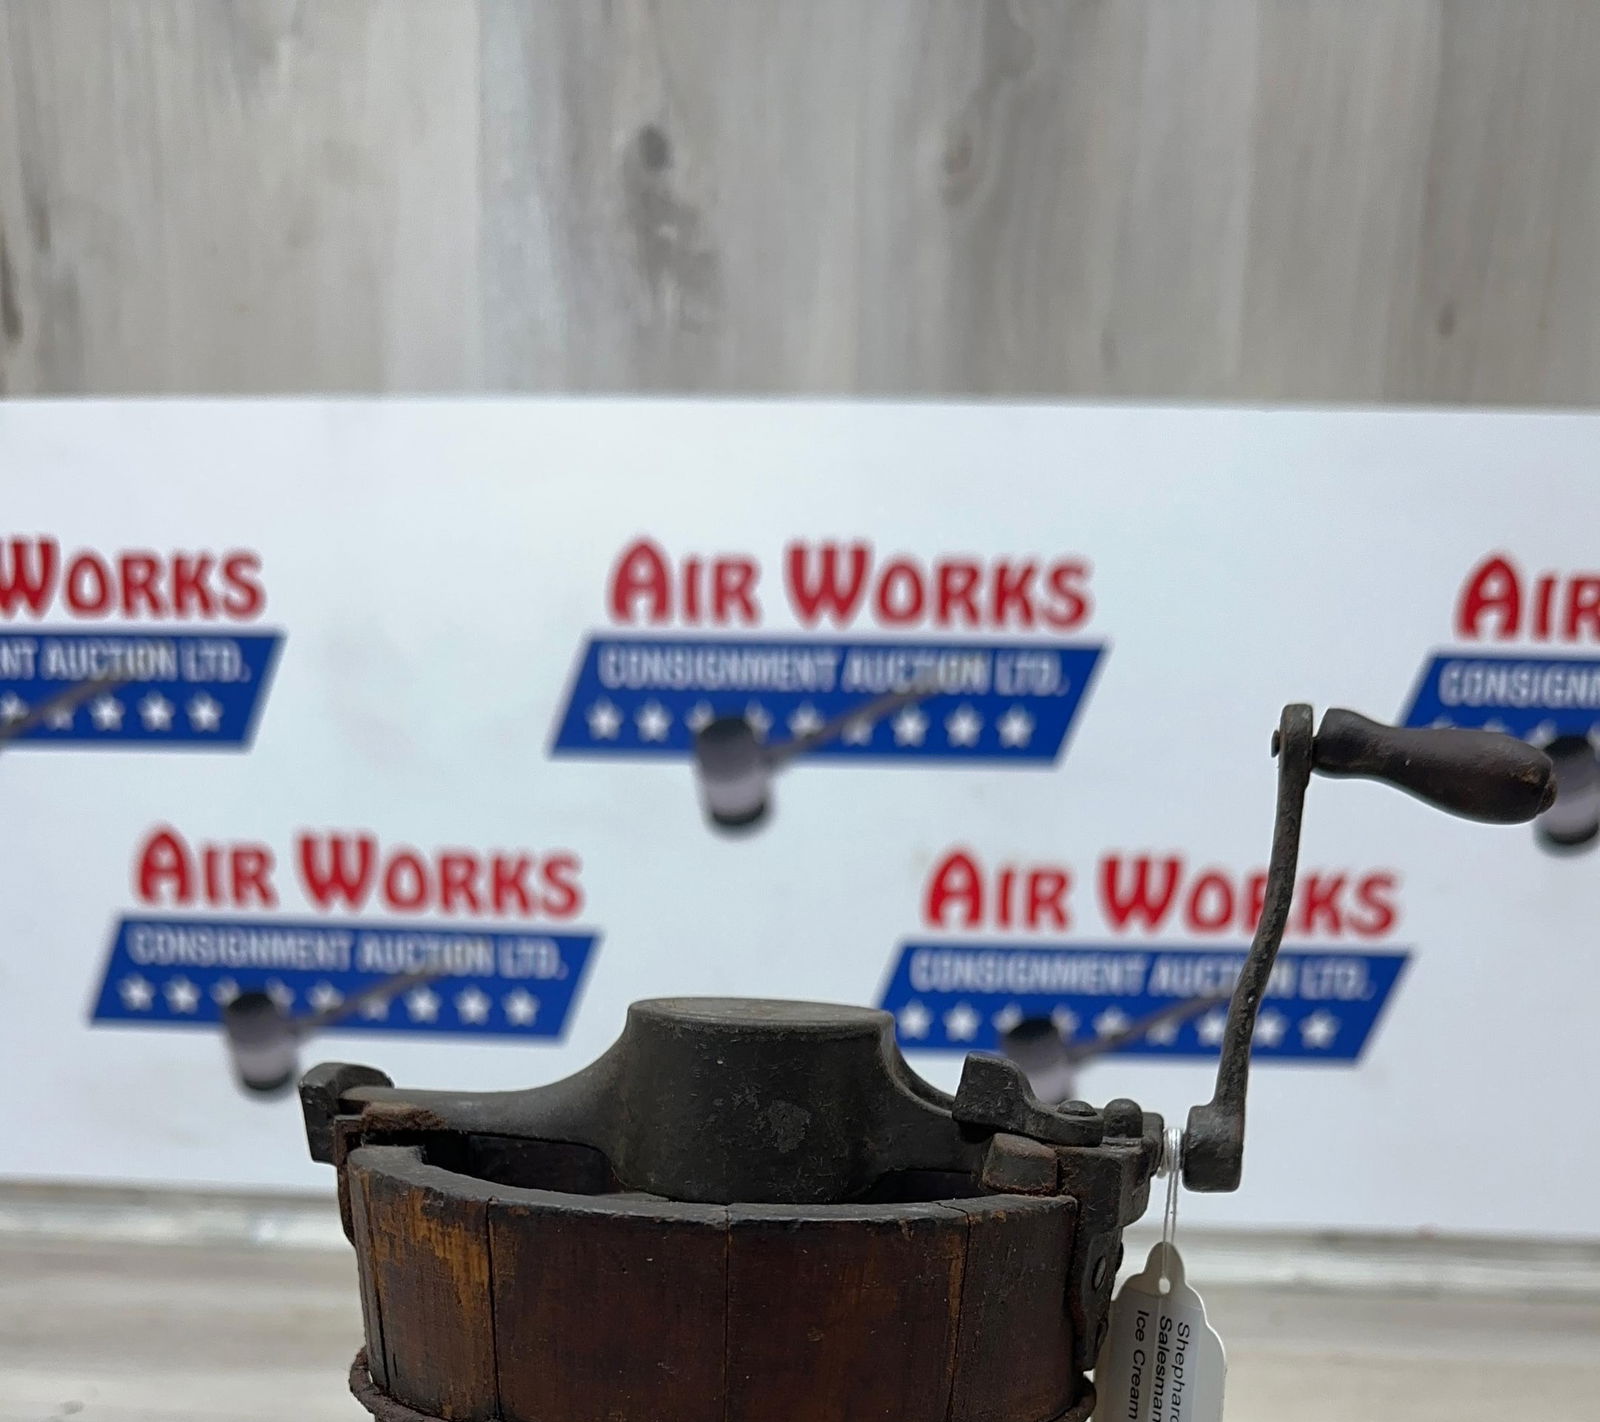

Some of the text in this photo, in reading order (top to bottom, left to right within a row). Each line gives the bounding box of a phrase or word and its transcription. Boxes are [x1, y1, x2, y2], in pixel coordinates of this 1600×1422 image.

[606, 536, 1096, 632] AIR WORKS
[1454, 552, 1600, 642] AIR
[40, 638, 178, 683] AUCTION
[598, 645, 838, 693] CONSIGNMENT
[840, 647, 989, 695] AUCTION
[1438, 661, 1600, 710] CONSIGN
[132, 821, 584, 920] AIR WORKS
[921, 842, 1072, 933] AIR
[126, 922, 353, 972] CONSIGNMENT
[356, 930, 496, 977] AUCTION
[909, 949, 1148, 997] CONSIGNMENT
[1148, 952, 1298, 1000] AUCTN
[1134, 1309, 1149, 1342] Ice
[1127, 1348, 1146, 1421] Cream
